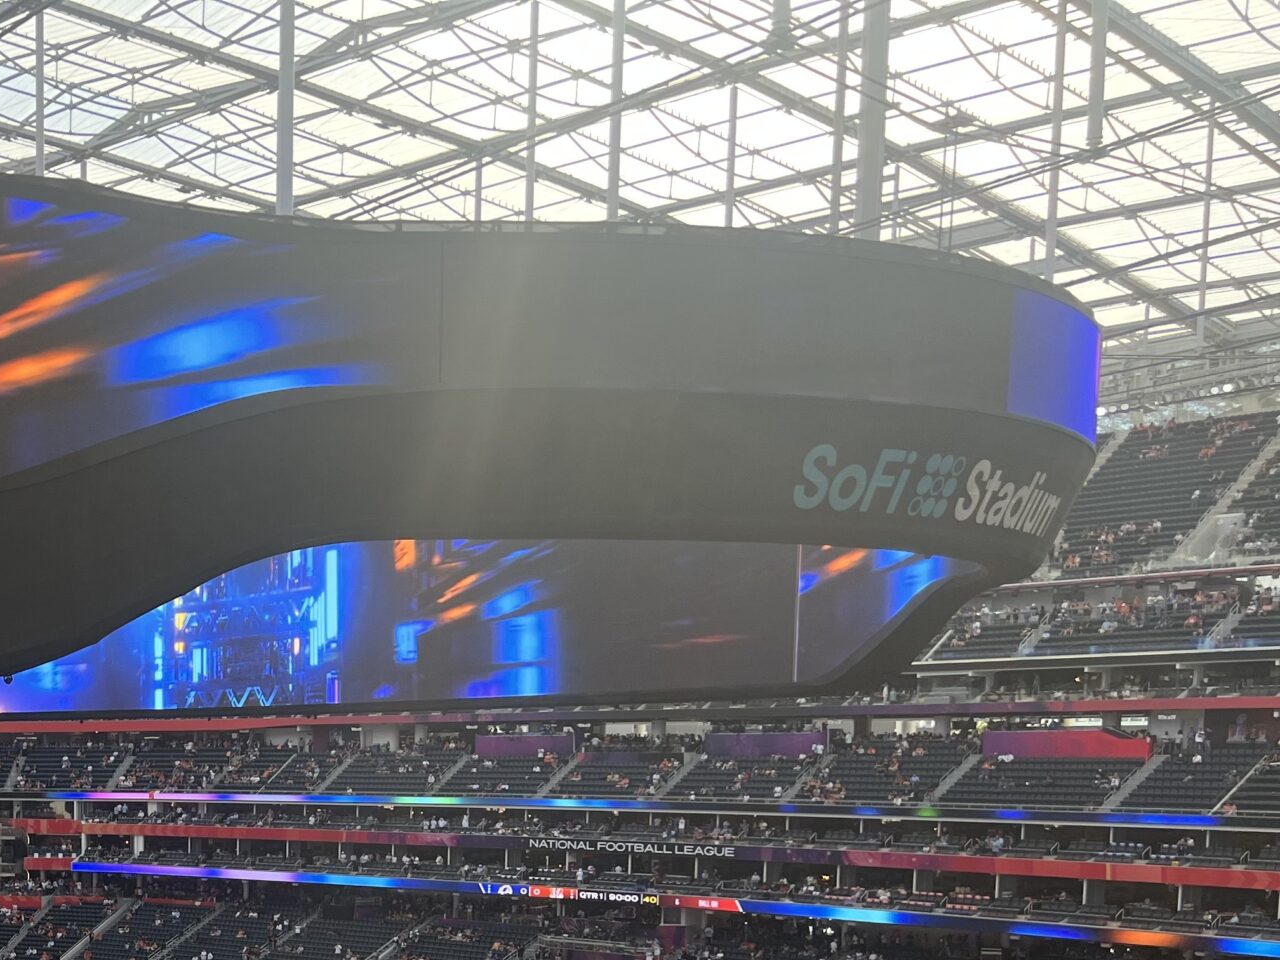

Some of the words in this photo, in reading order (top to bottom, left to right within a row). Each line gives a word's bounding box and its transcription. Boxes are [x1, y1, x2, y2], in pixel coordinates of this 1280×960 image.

[793, 444, 917, 514] SoFi
[954, 459, 1061, 538] Stadium
[529, 838, 594, 850] NATIONAL
[597, 842, 673, 854] FOOTBALL
[675, 845, 735, 857] LEAGUE
[579, 891, 598, 900] QTR
[609, 894, 639, 903] 90:00
[643, 896, 657, 904] 40
